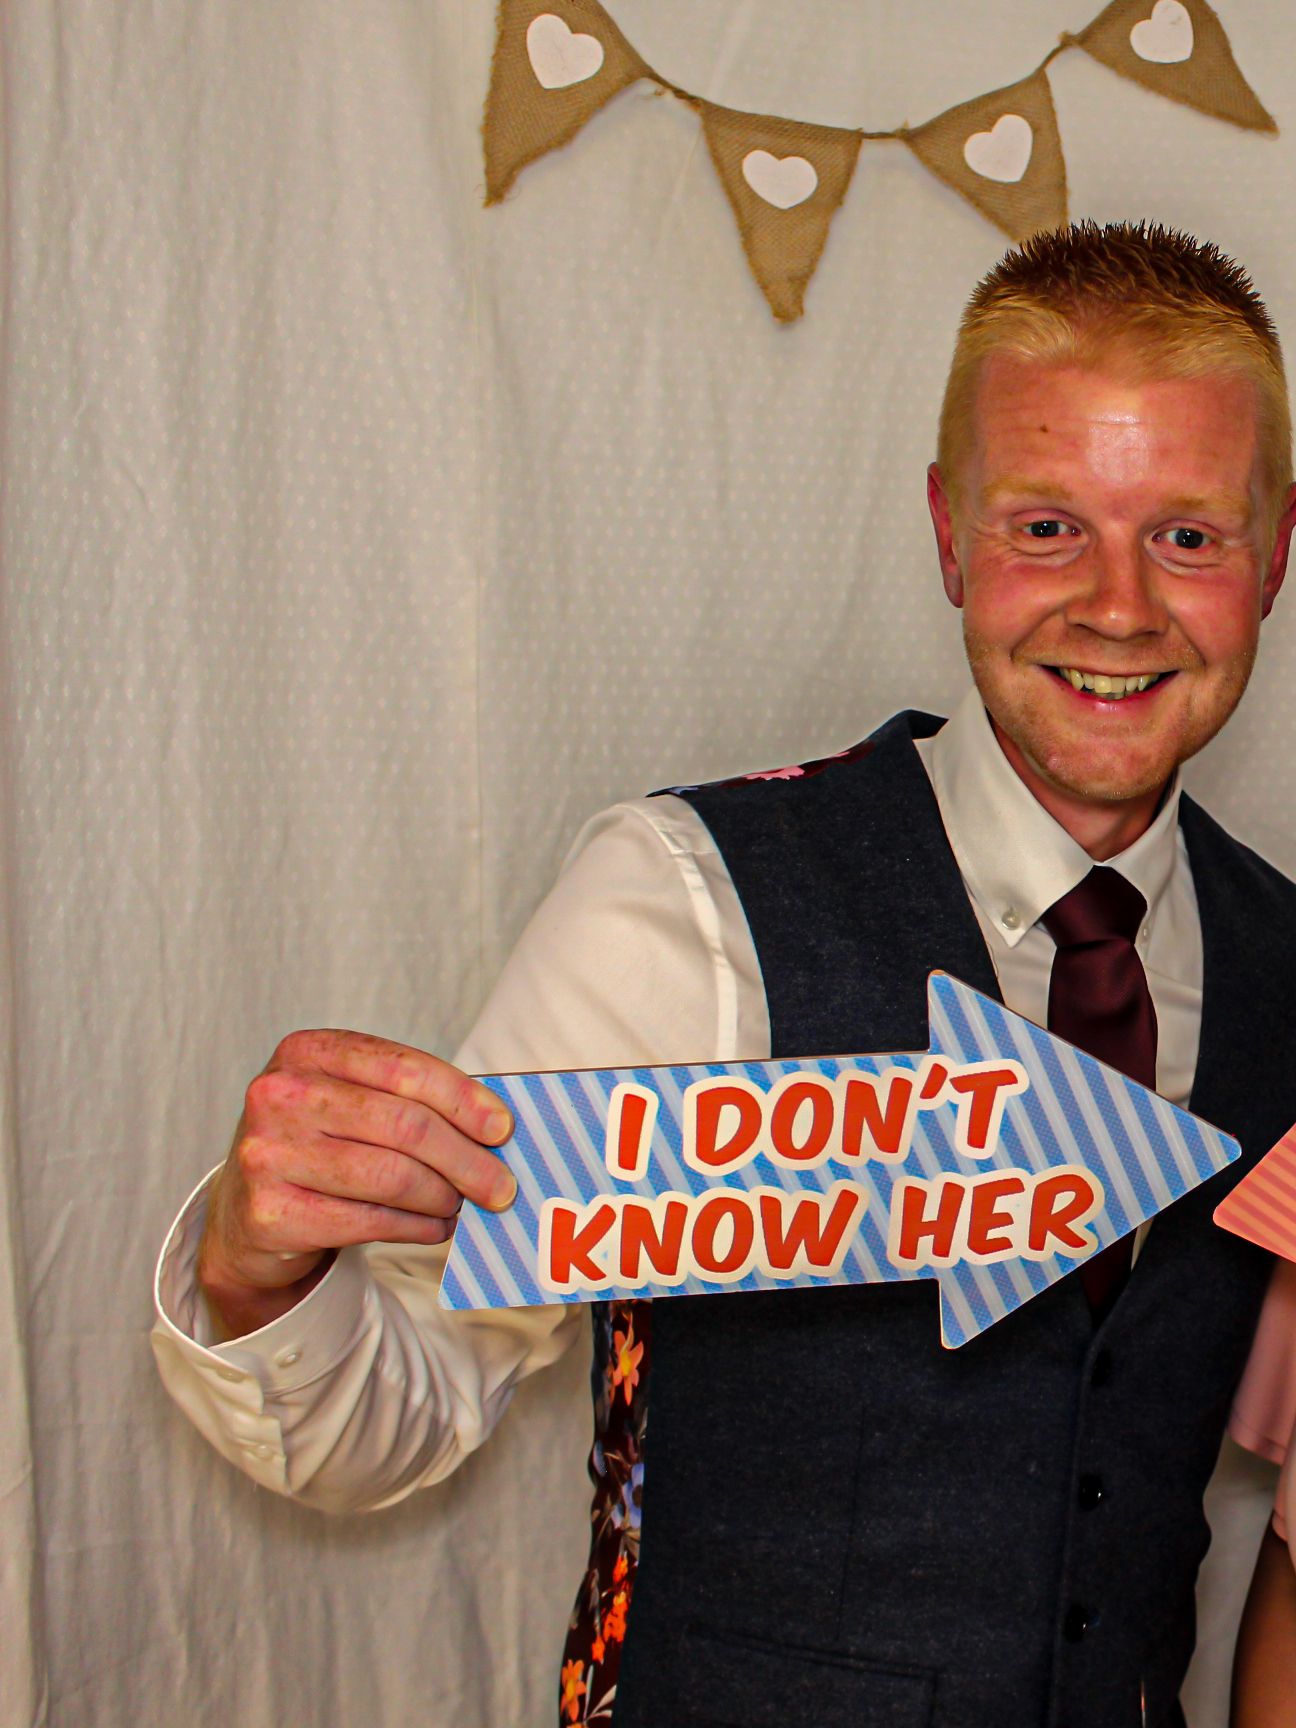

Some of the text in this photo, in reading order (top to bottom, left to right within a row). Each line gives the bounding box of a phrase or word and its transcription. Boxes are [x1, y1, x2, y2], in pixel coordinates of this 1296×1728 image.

[615, 1061, 1021, 1173] I DON'T
[548, 1172, 1095, 1286] KNOW HER
